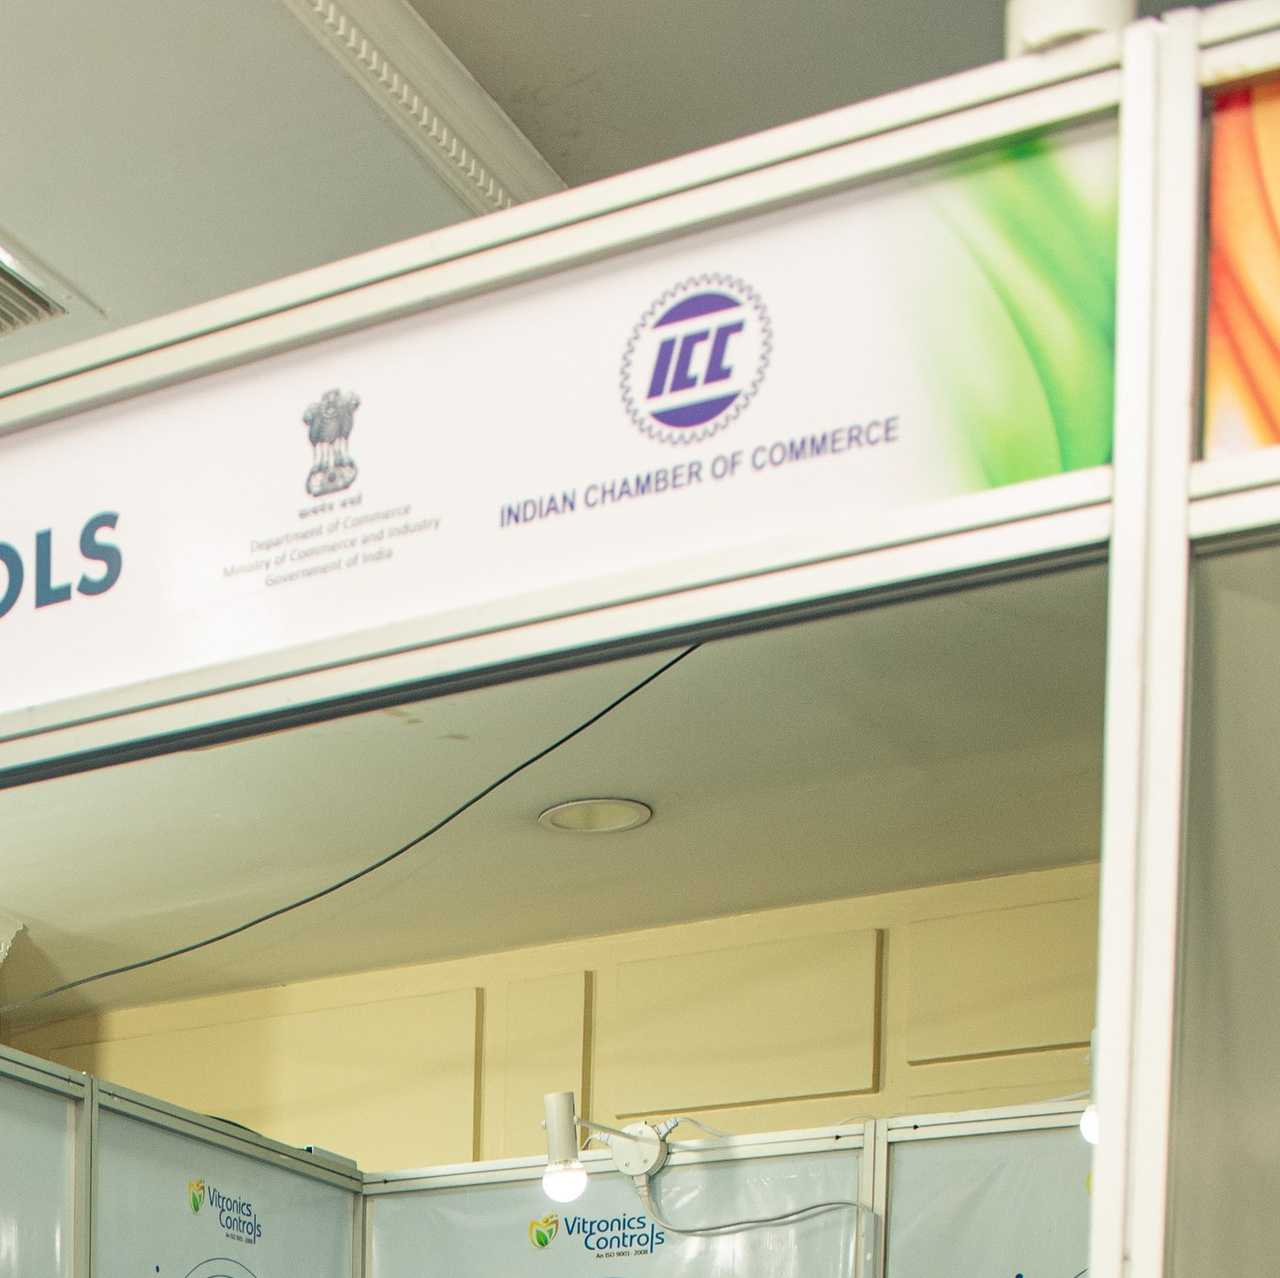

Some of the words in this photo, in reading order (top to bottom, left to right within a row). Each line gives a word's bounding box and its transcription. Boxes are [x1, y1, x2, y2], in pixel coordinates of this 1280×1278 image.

[646, 318, 746, 400] ICC
[499, 489, 576, 528] INDIAN
[584, 461, 702, 508] CHAMBER
[710, 450, 743, 481] OF
[751, 416, 900, 472] COMMERCE
[223, 558, 271, 579] Ministry
[274, 552, 288, 566] of
[290, 536, 358, 562] Commerce
[361, 529, 384, 545] and
[388, 516, 441, 540] Industry
[250, 526, 323, 553] Department
[327, 520, 341, 534] of
[343, 503, 412, 529] Commerce
[265, 558, 343, 587] Government
[346, 553, 359, 568] of
[362, 547, 393, 563] India
[208, 1186, 252, 1217] Vitronics
[219, 1209, 262, 1245] Controls
[564, 1213, 646, 1235] Vitronics
[584, 1223, 665, 1254] Controls
